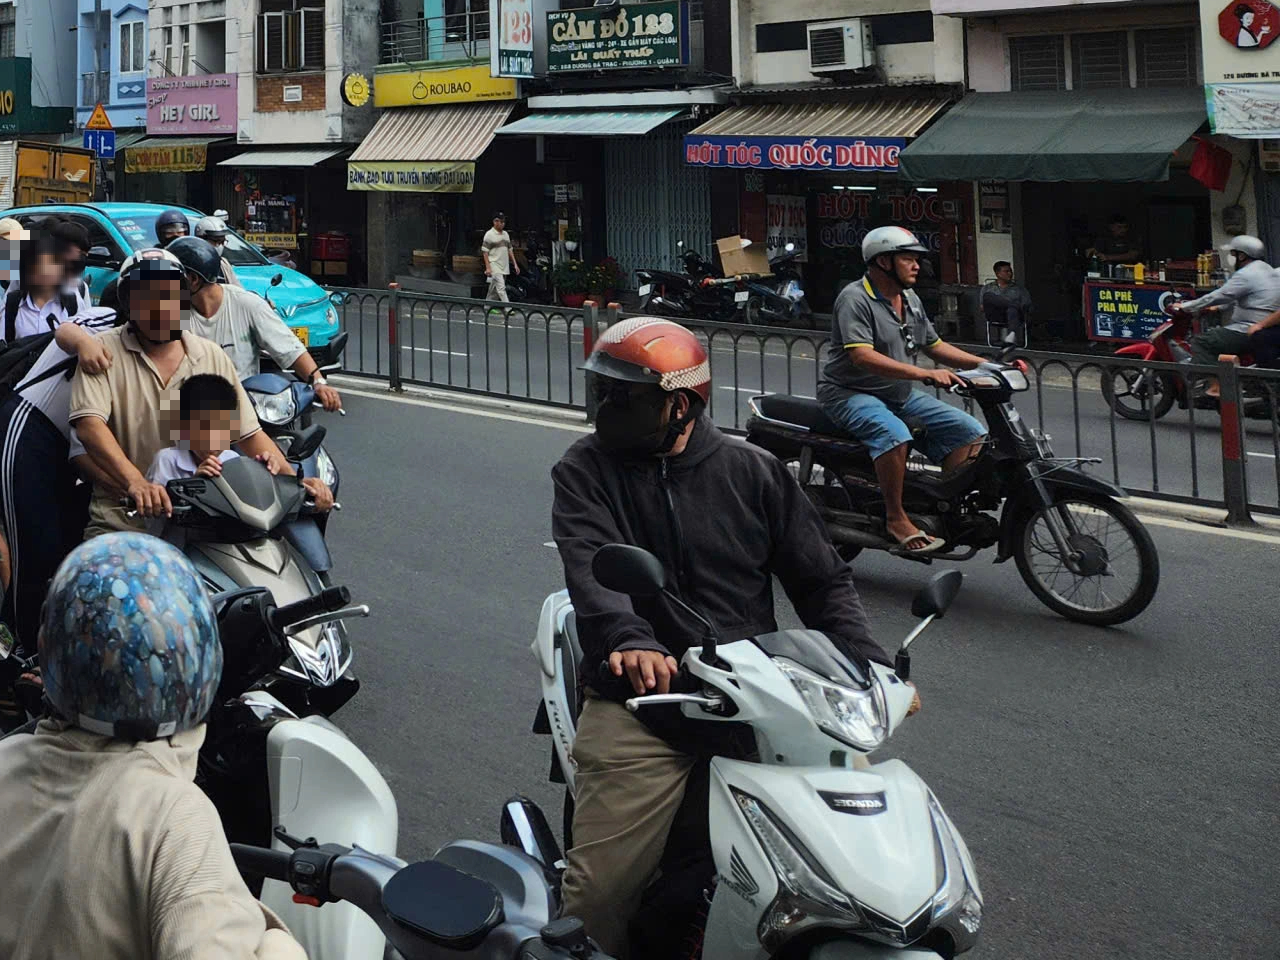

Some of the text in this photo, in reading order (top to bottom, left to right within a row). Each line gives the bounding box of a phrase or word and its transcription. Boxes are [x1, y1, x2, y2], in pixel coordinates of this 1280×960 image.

[503, 10, 532, 45] 123
[599, 7, 629, 39] ĐỒ
[632, 12, 675, 36] 123
[430, 81, 472, 96] ROUBAO
[160, 103, 220, 123] HEY GIRL
[686, 138, 901, 168] HỚT TÓC QUỐC DŨNG
[1114, 289, 1133, 302] PHÊ
[1097, 302, 1116, 312] PHA
[833, 798, 883, 808] HONDA
